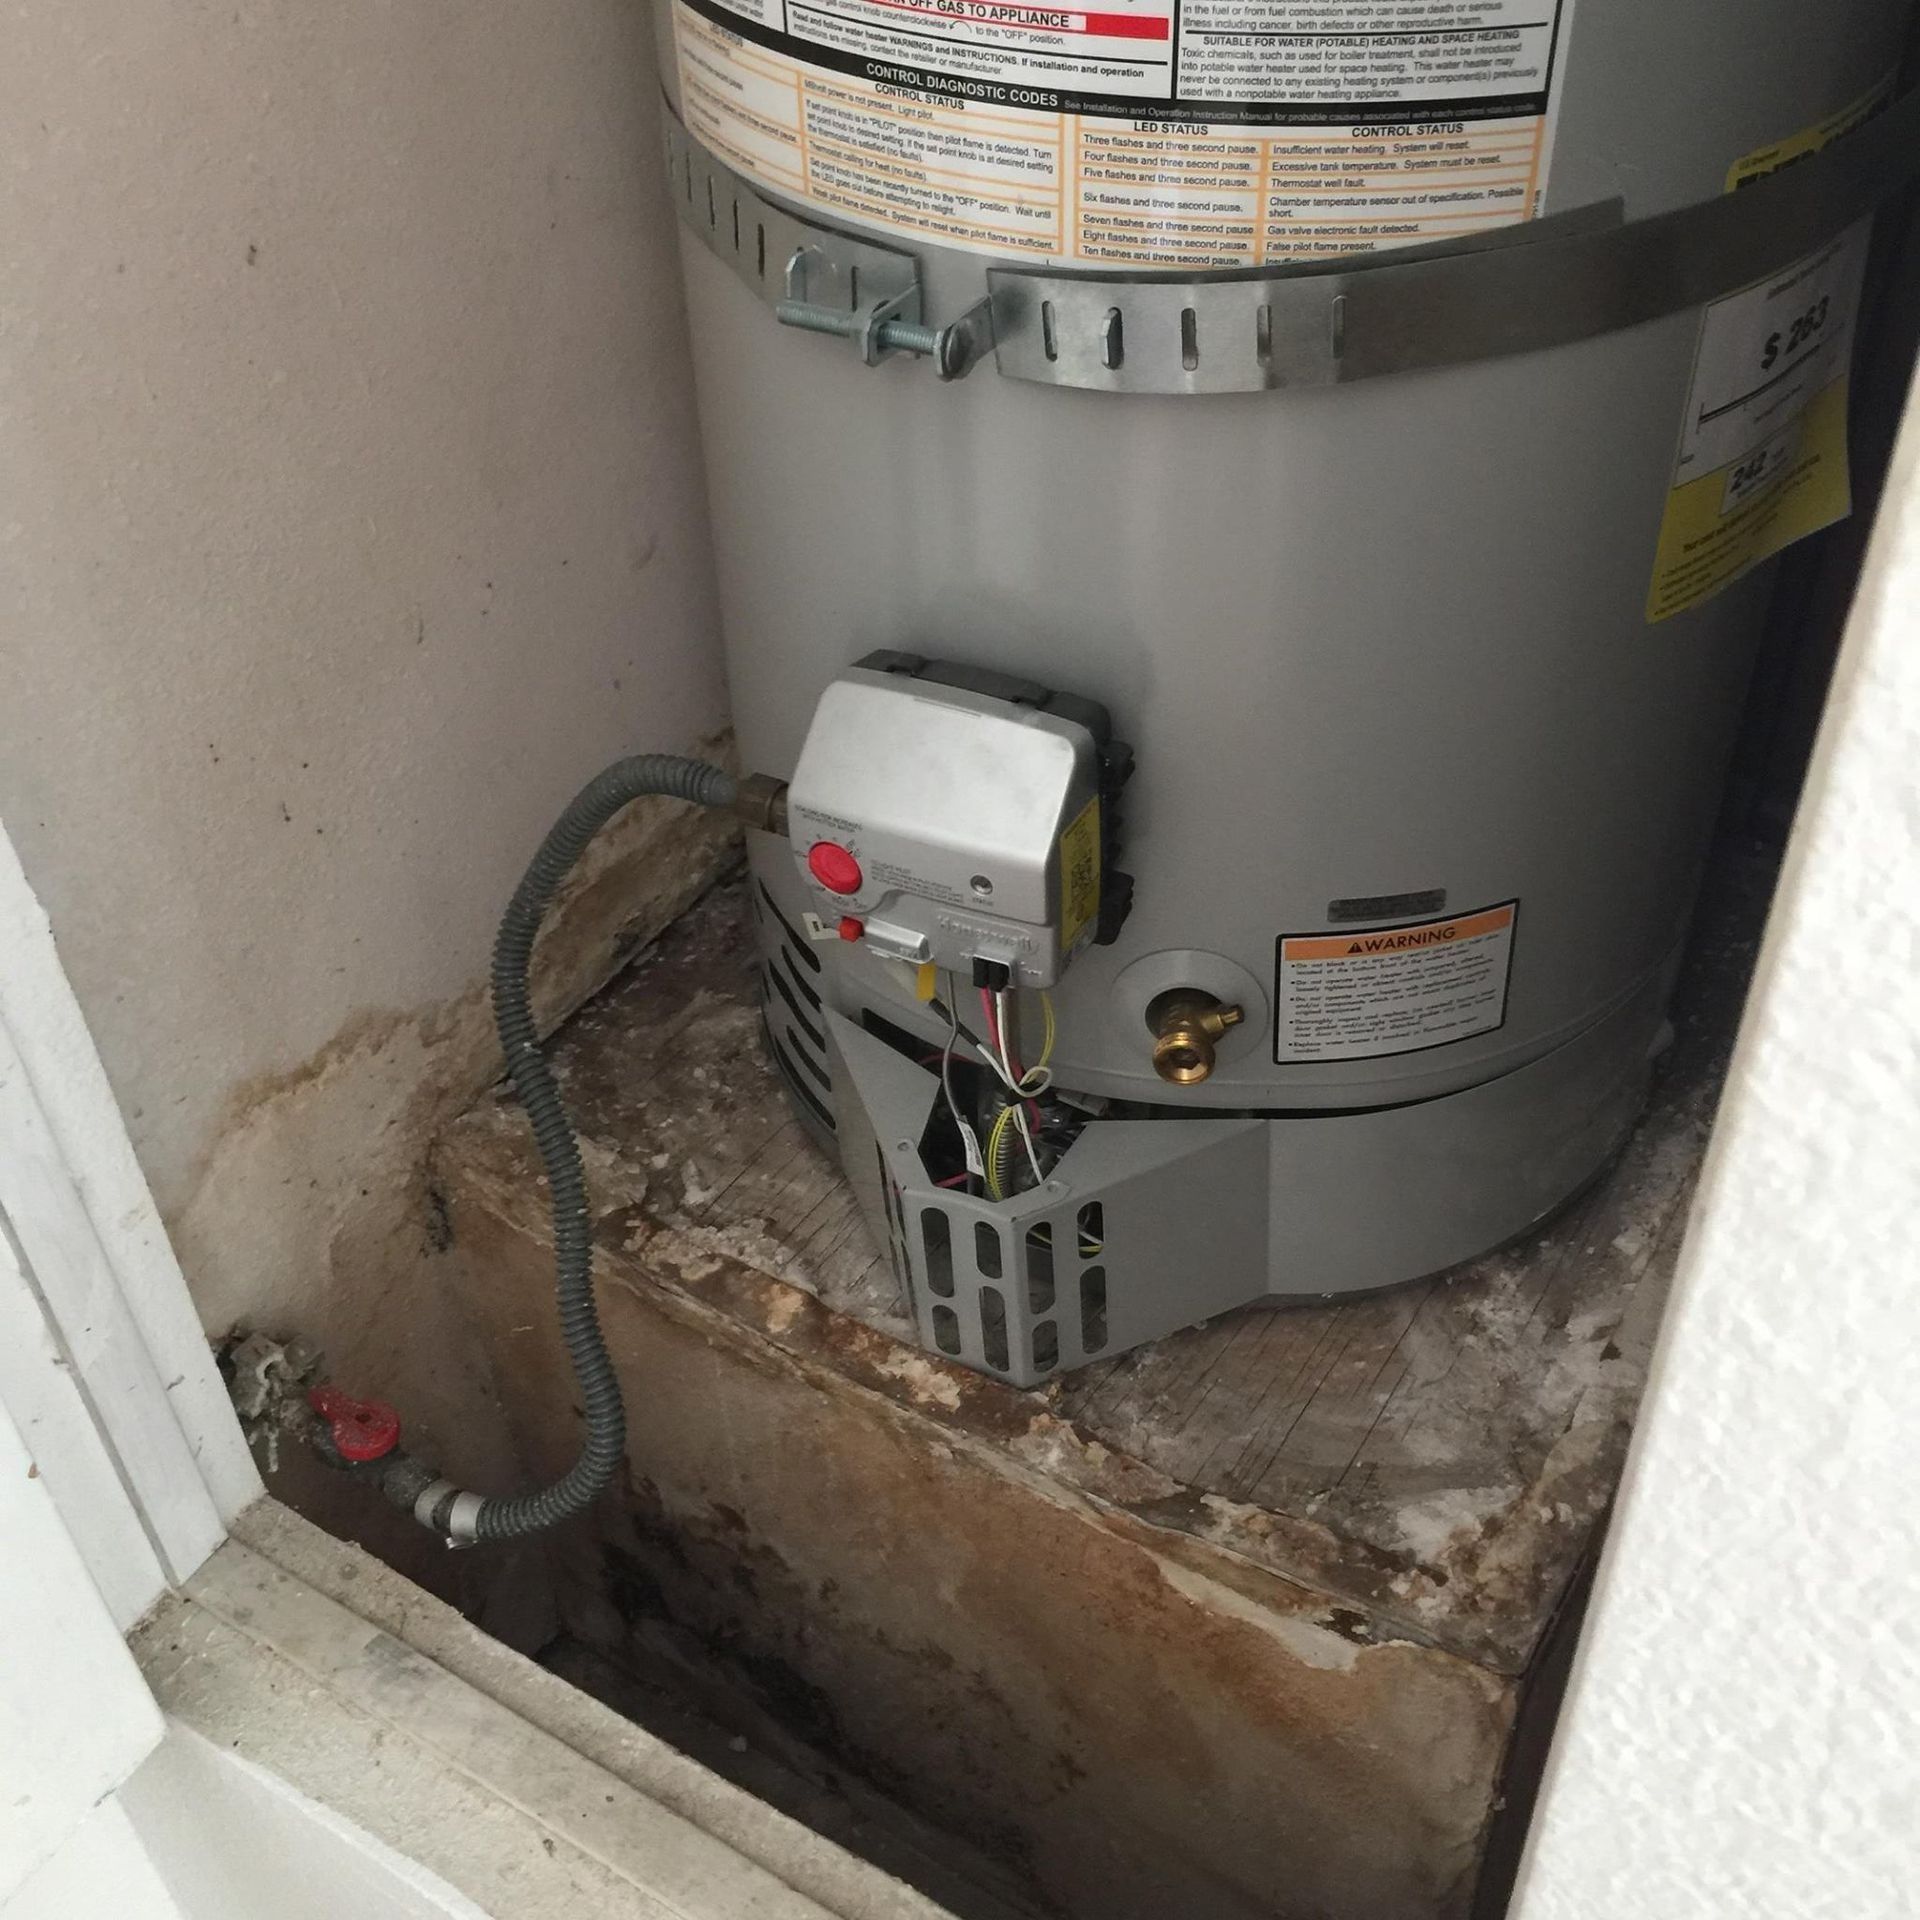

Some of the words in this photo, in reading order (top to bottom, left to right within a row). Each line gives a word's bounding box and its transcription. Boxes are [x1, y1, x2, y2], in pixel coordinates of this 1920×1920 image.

[937, 0, 964, 14] GAS
[968, 4, 986, 17] TO
[990, 8, 1069, 27] APPLIANCE
[1195, 6, 1209, 14] the
[1212, 6, 1229, 14] fuel
[1245, 7, 1265, 15] from
[1269, 7, 1285, 15] fuel
[1289, 7, 1343, 15] combustion
[1428, 5, 1454, 13] death
[1215, 19, 1256, 30] including
[1297, 20, 1317, 28] birth
[1320, 20, 1354, 29] defects
[1370, 19, 1393, 28] other
[985, 28, 998, 36] the
[1030, 34, 1065, 44] position.
[1204, 37, 1251, 46] SUITABLE
[1255, 38, 1275, 46] FOR
[1278, 38, 1313, 47] WATER
[1316, 38, 1369, 49] (POTABLE)
[1373, 36, 1415, 46] HEATING
[1418, 35, 1439, 44] AND
[1442, 33, 1474, 43] SPACE
[1477, 31, 1520, 41] HEATING
[866, 28, 887, 40] heater
[890, 33, 933, 51] WARNINGS
[936, 46, 950, 54] and
[1030, 60, 1078, 72] installation
[1081, 66, 1097, 74] and
[1101, 69, 1144, 77] operation
[1182, 49, 1205, 57] Toxic
[1260, 51, 1282, 59] such
[1299, 51, 1321, 59] used
[1325, 51, 1337, 59] for
[1341, 51, 1365, 59] boiler
[1443, 48, 1457, 56] not
[1460, 47, 1471, 55] be
[1182, 62, 1198, 70] into
[1201, 62, 1234, 73] potable
[1238, 63, 1262, 72] water
[1266, 64, 1295, 72] heater
[1299, 64, 1321, 72] used
[1325, 64, 1337, 72] for
[1340, 66, 1367, 74] space
[1414, 62, 1432, 70] This
[1436, 60, 1460, 69] water
[866, 63, 924, 86] CONTROL
[927, 77, 1006, 99] DIAGNOSTIC
[1010, 90, 1058, 106] CODES
[1209, 76, 1220, 84] be
[1223, 77, 1271, 85] connected
[1274, 77, 1283, 85] to
[1285, 80, 1302, 88] any
[1305, 78, 1340, 88] existing
[1344, 78, 1377, 87] heating
[1381, 75, 1413, 86] system
[875, 84, 921, 101] CONTROL
[926, 94, 964, 110] STATUS
[1206, 89, 1223, 97] with
[1235, 90, 1286, 99] nonpotable
[1317, 91, 1352, 100] heating
[1084, 102, 1127, 113] Installation
[1131, 106, 1146, 114] and
[1134, 121, 1158, 132] LED
[1161, 123, 1208, 135] STATUS
[1352, 127, 1412, 137] CONTROL
[1417, 123, 1464, 135] STATUS
[1084, 135, 1110, 144] Three
[1112, 137, 1144, 148] flashes
[1146, 141, 1163, 149] and
[1166, 141, 1189, 150] three
[1192, 144, 1225, 152] second
[1324, 145, 1349, 153] water
[1393, 144, 1427, 154] System
[1430, 142, 1443, 150] will
[1085, 152, 1104, 160] Four
[1107, 154, 1138, 164] flashes
[1141, 157, 1157, 165] and
[1161, 158, 1183, 167] three
[1186, 161, 1219, 169] second
[1272, 162, 1317, 170] Excessive
[1320, 162, 1339, 170] tank
[1404, 160, 1437, 171] System
[1441, 158, 1462, 167] must
[1464, 157, 1475, 166] be
[1085, 168, 1102, 177] Five
[1105, 170, 1136, 180] flashes
[1139, 174, 1155, 182] and
[1158, 174, 1181, 184] three
[1184, 178, 1216, 186] second
[1220, 180, 1249, 188] pause.
[1271, 179, 1321, 187] Thermostat
[1324, 179, 1341, 187] well
[1084, 192, 1097, 201] Six
[1100, 194, 1130, 205] flashes
[1133, 199, 1149, 207] and
[1152, 200, 1174, 208] three
[1177, 203, 1210, 211] second
[1213, 205, 1243, 213] pause.
[1270, 198, 1310, 206] Chamber
[1313, 197, 1367, 208] temperature
[1401, 196, 1416, 204] out
[1418, 195, 1427, 203] of
[1269, 210, 1293, 218] short.
[1084, 215, 1111, 224] Seven
[1113, 218, 1144, 228] flashes
[1166, 222, 1188, 231] three
[1191, 225, 1223, 233] second
[1268, 226, 1286, 235] Gas
[1289, 226, 1311, 235] valve
[1314, 226, 1356, 235] electronic
[1360, 225, 1378, 234] fault
[1084, 230, 1105, 241] Eight
[1108, 233, 1138, 243] flashes
[1141, 237, 1157, 245] and
[1160, 238, 1182, 246] three
[1185, 241, 1217, 249] second
[1083, 246, 1098, 255] Ten
[1101, 248, 1131, 259] flashes
[1134, 252, 1150, 260] and
[1153, 253, 1175, 262] three
[1267, 242, 1291, 250] False
[1293, 242, 1311, 252] pilot
[1314, 242, 1338, 250] flame
[1760, 332, 1781, 370] $
[1784, 294, 1830, 355] 263
[1364, 926, 1456, 952] WARNING
